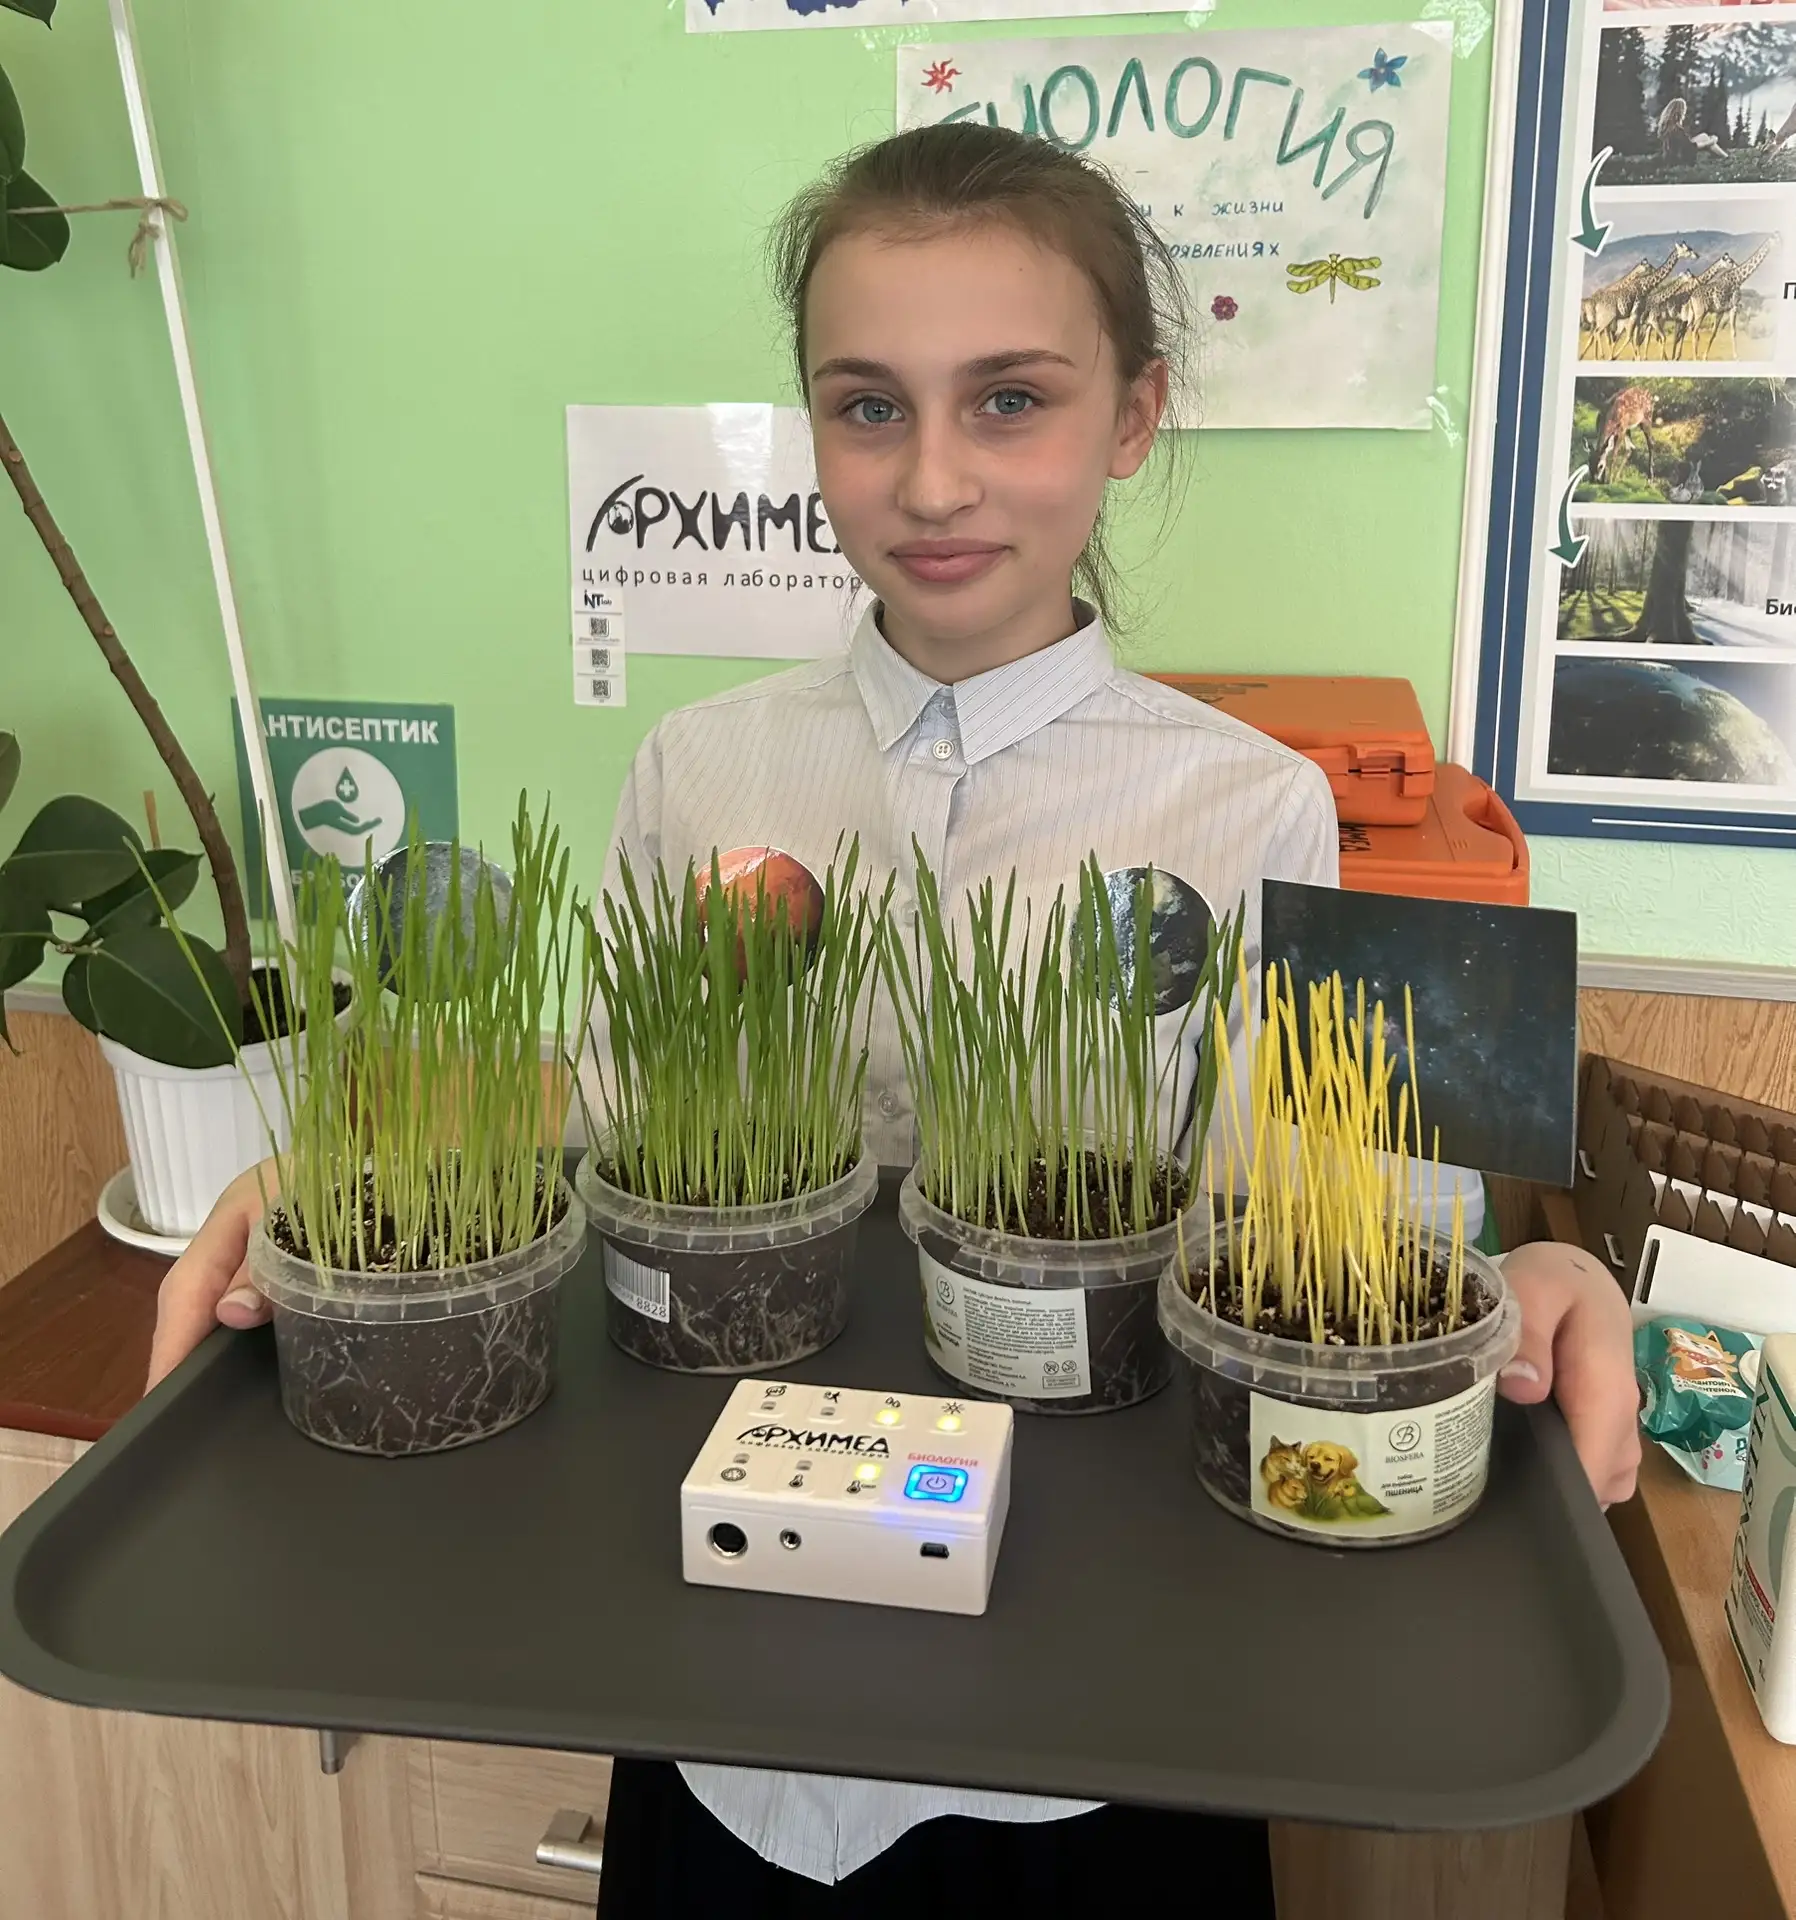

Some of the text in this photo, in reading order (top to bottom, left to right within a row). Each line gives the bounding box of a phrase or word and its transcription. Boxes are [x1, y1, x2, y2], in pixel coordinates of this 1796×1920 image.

[586, 474, 843, 553] АРХИМЕ
[583, 565, 708, 587] цифровая
[263, 714, 440, 745] НТИСЕПТИК
[907, 1452, 979, 1467] БИОЛОГИЯ
